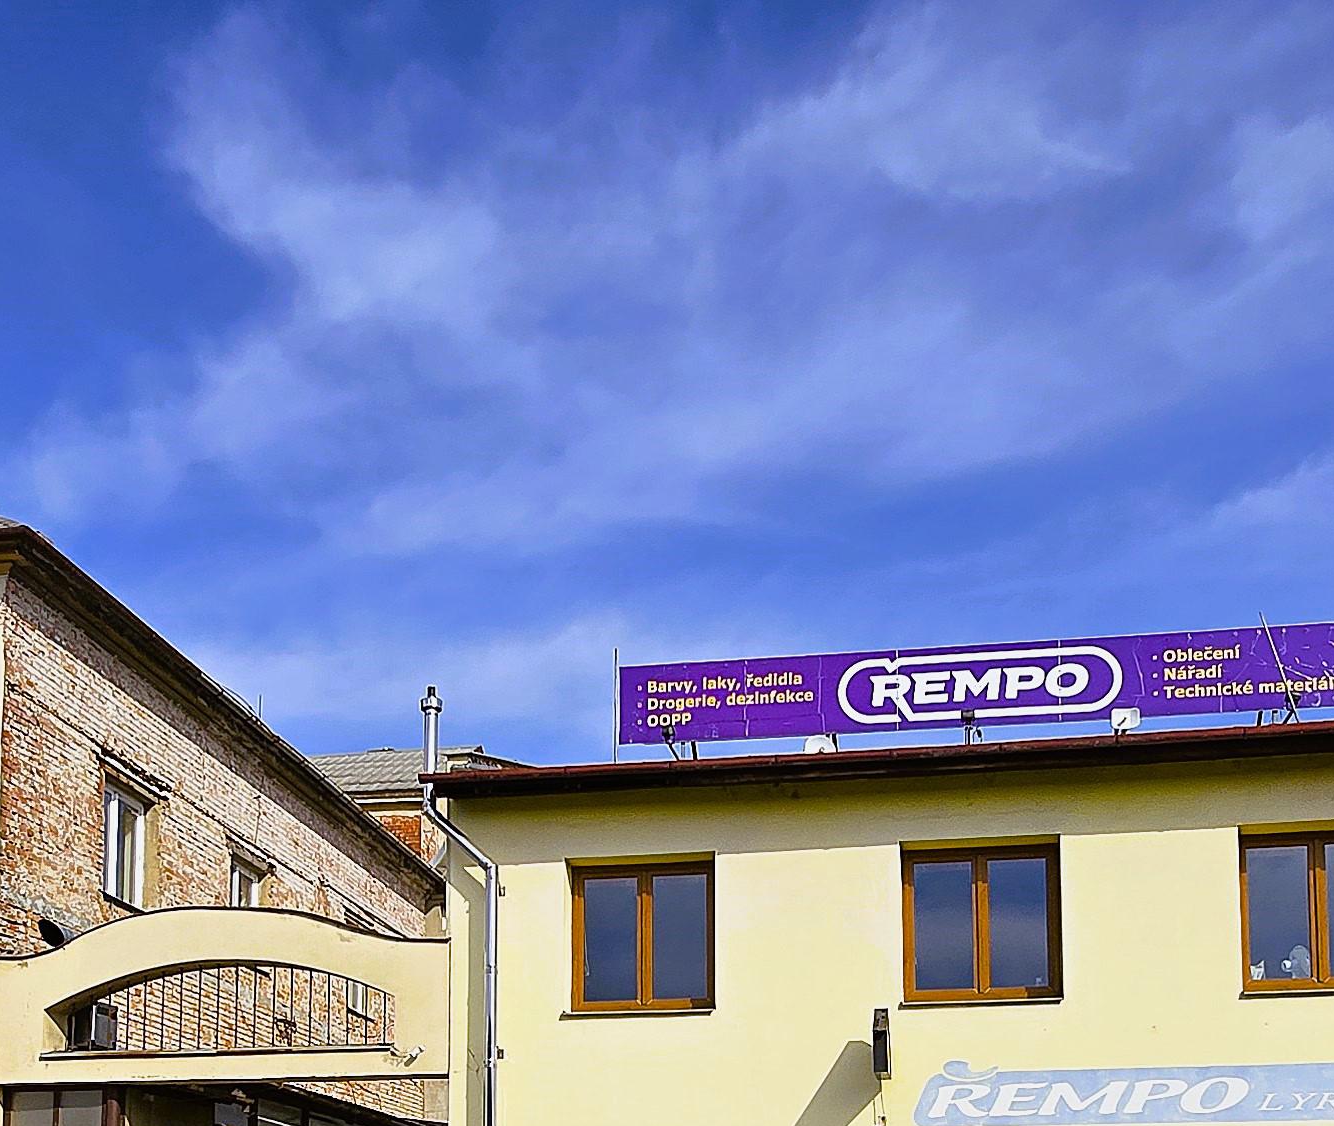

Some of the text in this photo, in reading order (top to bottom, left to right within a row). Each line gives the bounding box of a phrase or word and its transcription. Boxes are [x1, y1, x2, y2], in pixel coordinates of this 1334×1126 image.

[1162, 644, 1242, 663] Oblečení
[1163, 663, 1223, 681] Nářadí
[646, 672, 803, 694] Barvy, laky, ředidla
[1163, 680, 1254, 699] Technické
[646, 689, 814, 711] Drogerie, dezinfekce
[646, 712, 692, 727] OOPP
[927, 1060, 1250, 1118] ŘEMPO
